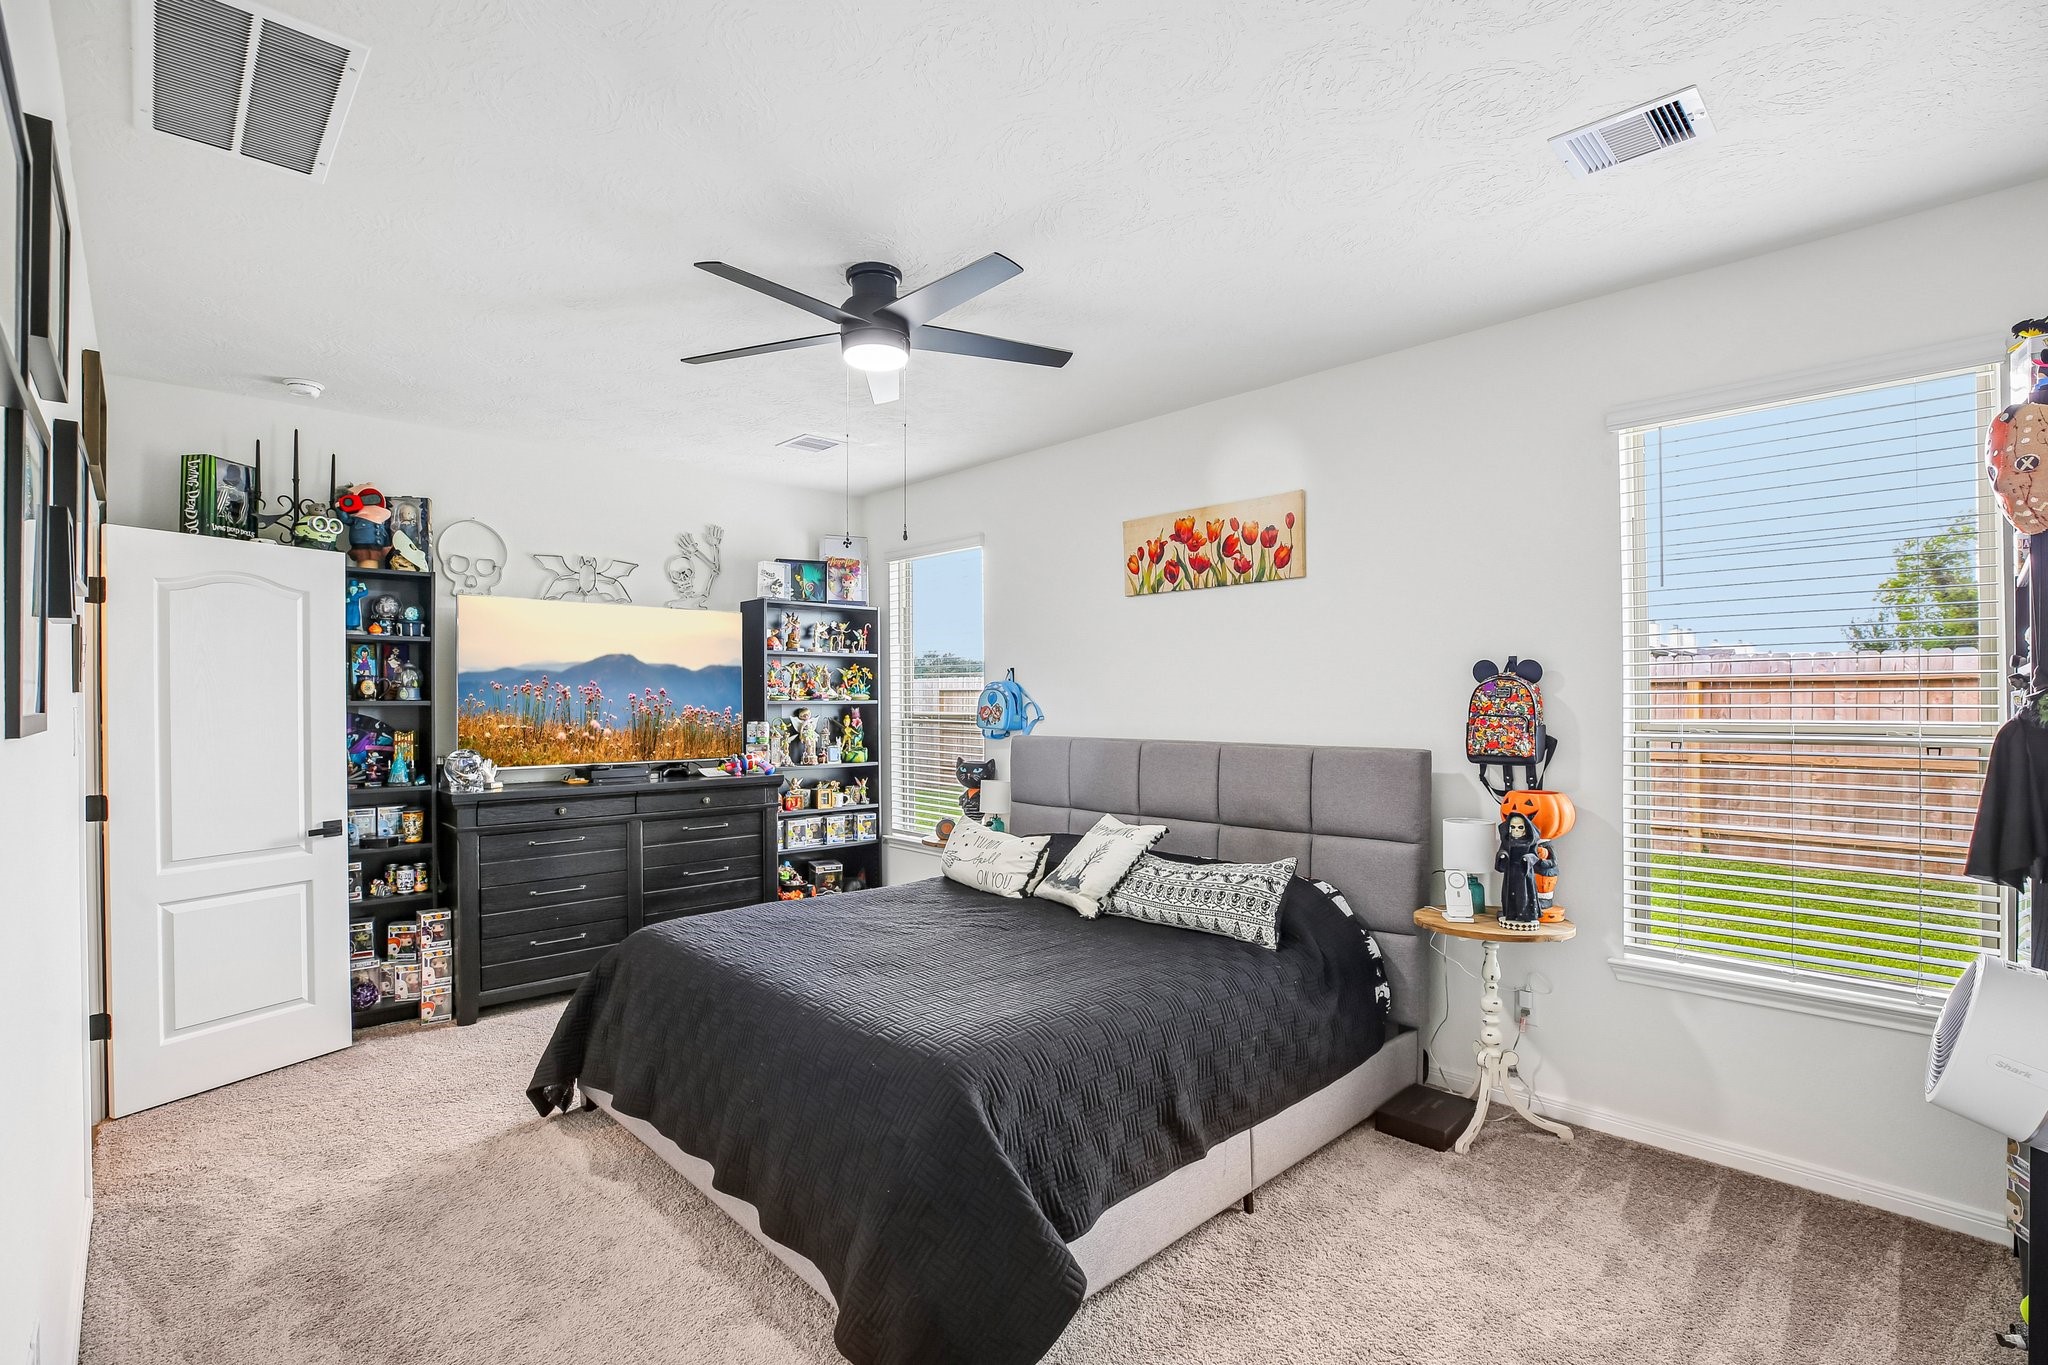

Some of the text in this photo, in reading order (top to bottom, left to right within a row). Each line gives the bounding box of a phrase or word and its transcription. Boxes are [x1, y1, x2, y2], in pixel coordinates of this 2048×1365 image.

[184, 490, 200, 519] DEAD
[976, 869, 1013, 890] ON YOU.
[1995, 1060, 2033, 1079] Shark
